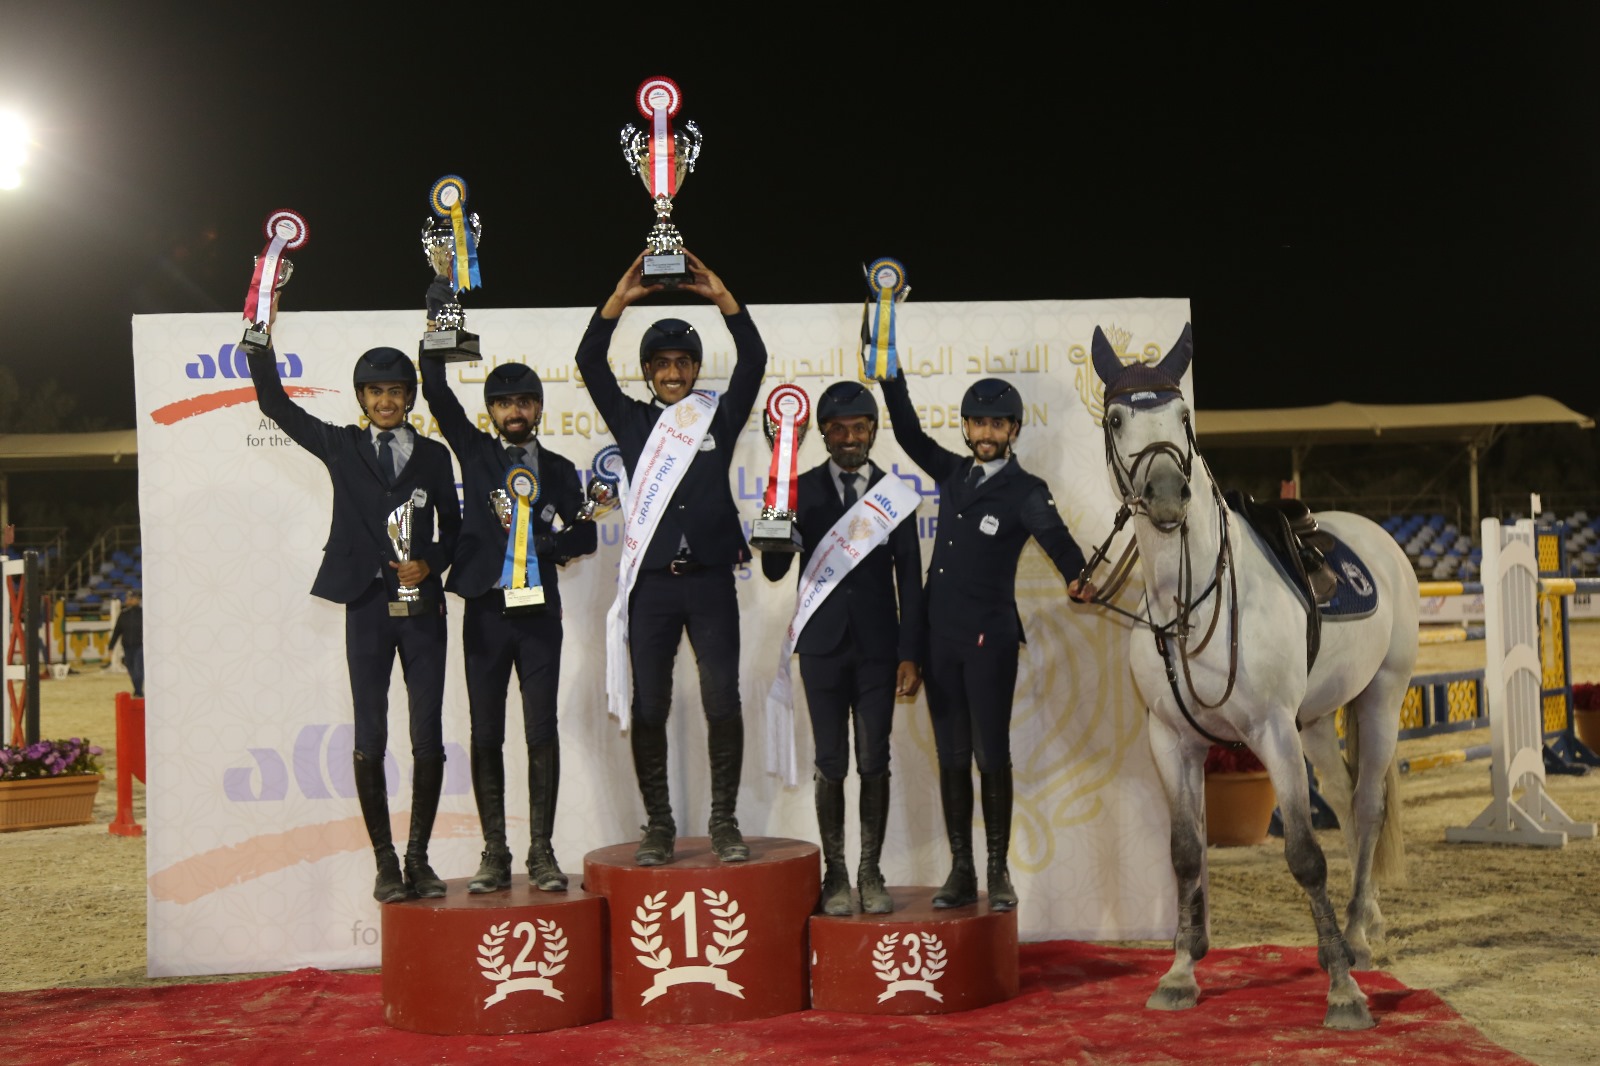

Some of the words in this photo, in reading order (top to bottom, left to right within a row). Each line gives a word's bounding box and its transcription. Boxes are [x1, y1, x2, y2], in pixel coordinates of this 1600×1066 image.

[966, 343, 1048, 374] الاتحاد
[246, 434, 265, 446] for
[269, 434, 291, 446] the
[666, 427, 695, 446] PLACE
[637, 483, 660, 525] GRAND
[655, 454, 677, 482] PRIX
[837, 536, 861, 559] PLACE
[804, 575, 828, 608] OPEN
[825, 566, 835, 578] 3
[671, 891, 699, 959] 1
[512, 921, 538, 973] 2
[902, 933, 922, 976] 3
